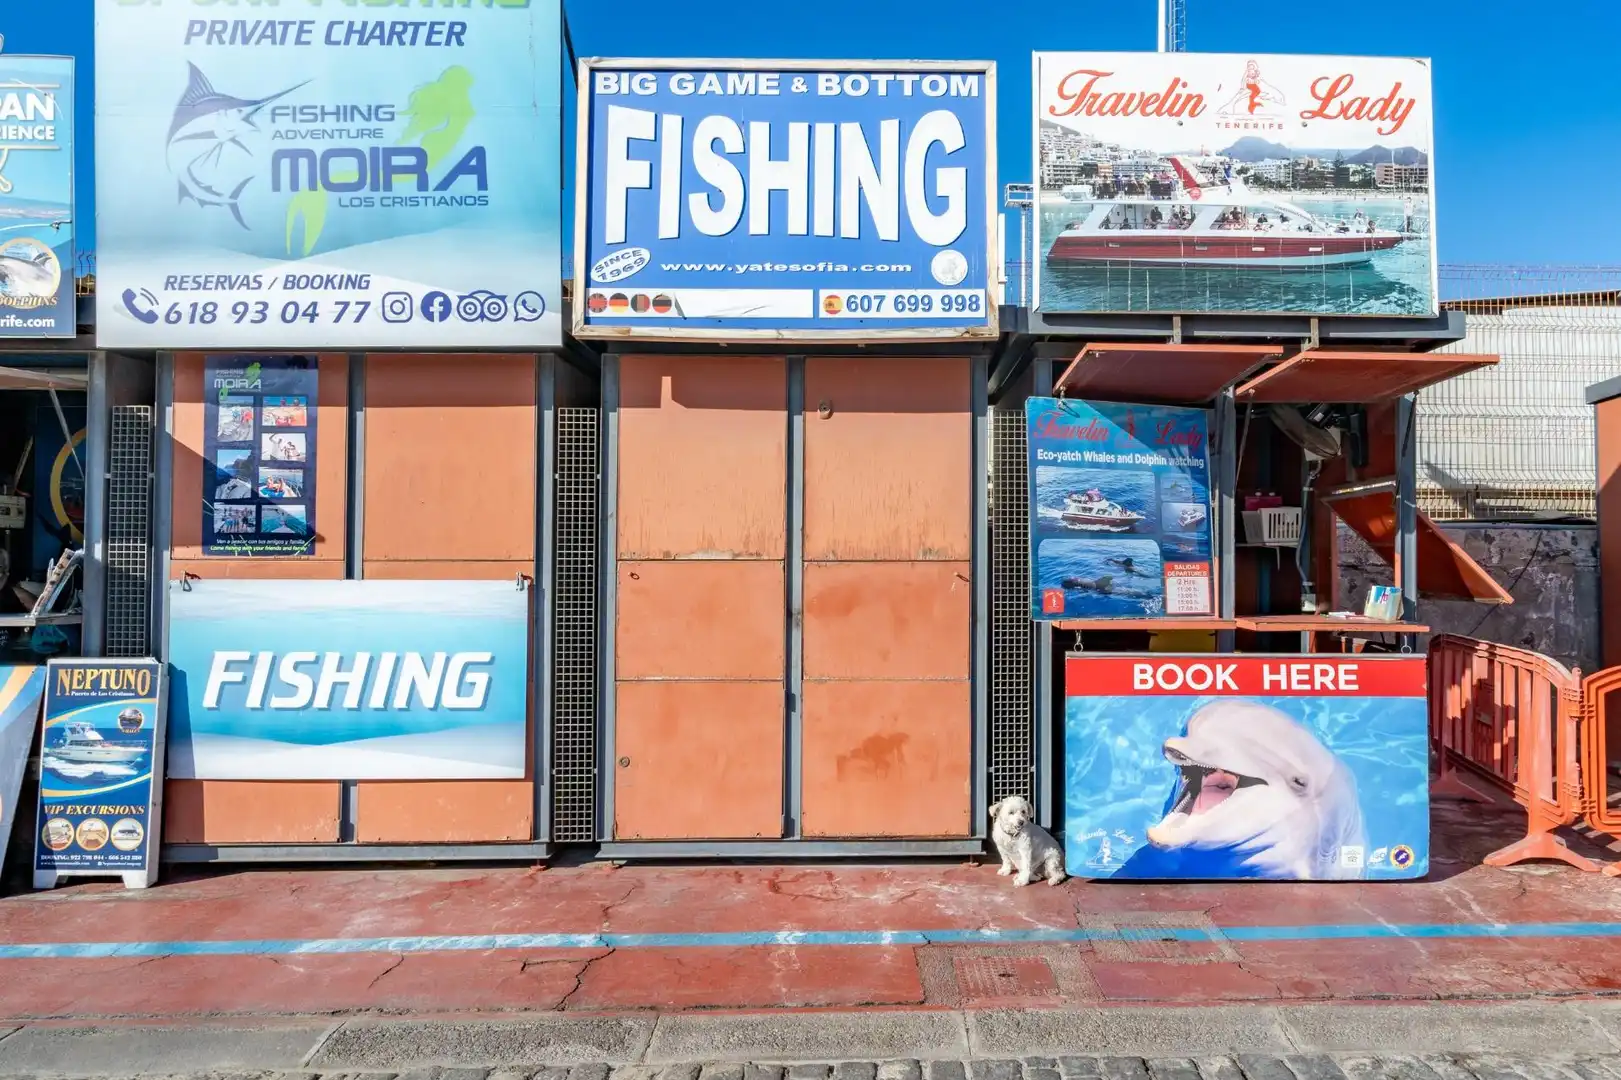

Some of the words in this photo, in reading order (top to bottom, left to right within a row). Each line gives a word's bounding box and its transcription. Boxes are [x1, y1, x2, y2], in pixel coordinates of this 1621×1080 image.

[183, 19, 316, 46] PRIVATE
[324, 20, 468, 47] CHARTER
[595, 72, 658, 96] BIG
[669, 73, 781, 96] GAME
[790, 76, 809, 94] &
[817, 74, 980, 98] BOTTOM
[0, 92, 55, 121] AN
[270, 104, 396, 124] FISHING
[1299, 73, 1416, 136] Lady
[272, 128, 384, 141] ADVENTURE
[1215, 121, 1284, 132] TENERIFE
[271, 145, 489, 193] MOIRA
[605, 103, 968, 247] FISHING
[338, 197, 375, 208] LOS
[380, 195, 489, 207] CRISTIANOS
[594, 249, 643, 273] SINCE
[597, 256, 646, 282] 1969
[660, 262, 913, 275] www.yatesofia.com
[164, 274, 263, 291] RESERVAS
[267, 276, 279, 291] /
[282, 273, 371, 291] BOOKING
[164, 301, 219, 325] 618
[230, 301, 270, 324] 93
[280, 300, 320, 324] 04
[332, 300, 371, 324] 77
[846, 294, 887, 313] 607
[893, 294, 934, 313] 699
[940, 294, 981, 313] 998
[213, 378, 262, 389] MOIRA
[1155, 418, 1203, 451] Lady
[1037, 448, 1082, 463] Eco-yatch
[1083, 451, 1115, 464] Whales
[1117, 453, 1133, 465] and
[1134, 455, 1167, 468] Dolphin
[1168, 456, 1205, 469] watching
[56, 668, 151, 697] NEPTUNO
[202, 650, 494, 710] FISHING
[1132, 663, 1240, 691] BOOK
[1262, 663, 1360, 691] HERE
[43, 804, 65, 815] VIP
[66, 804, 146, 816] EXCURSIONS
